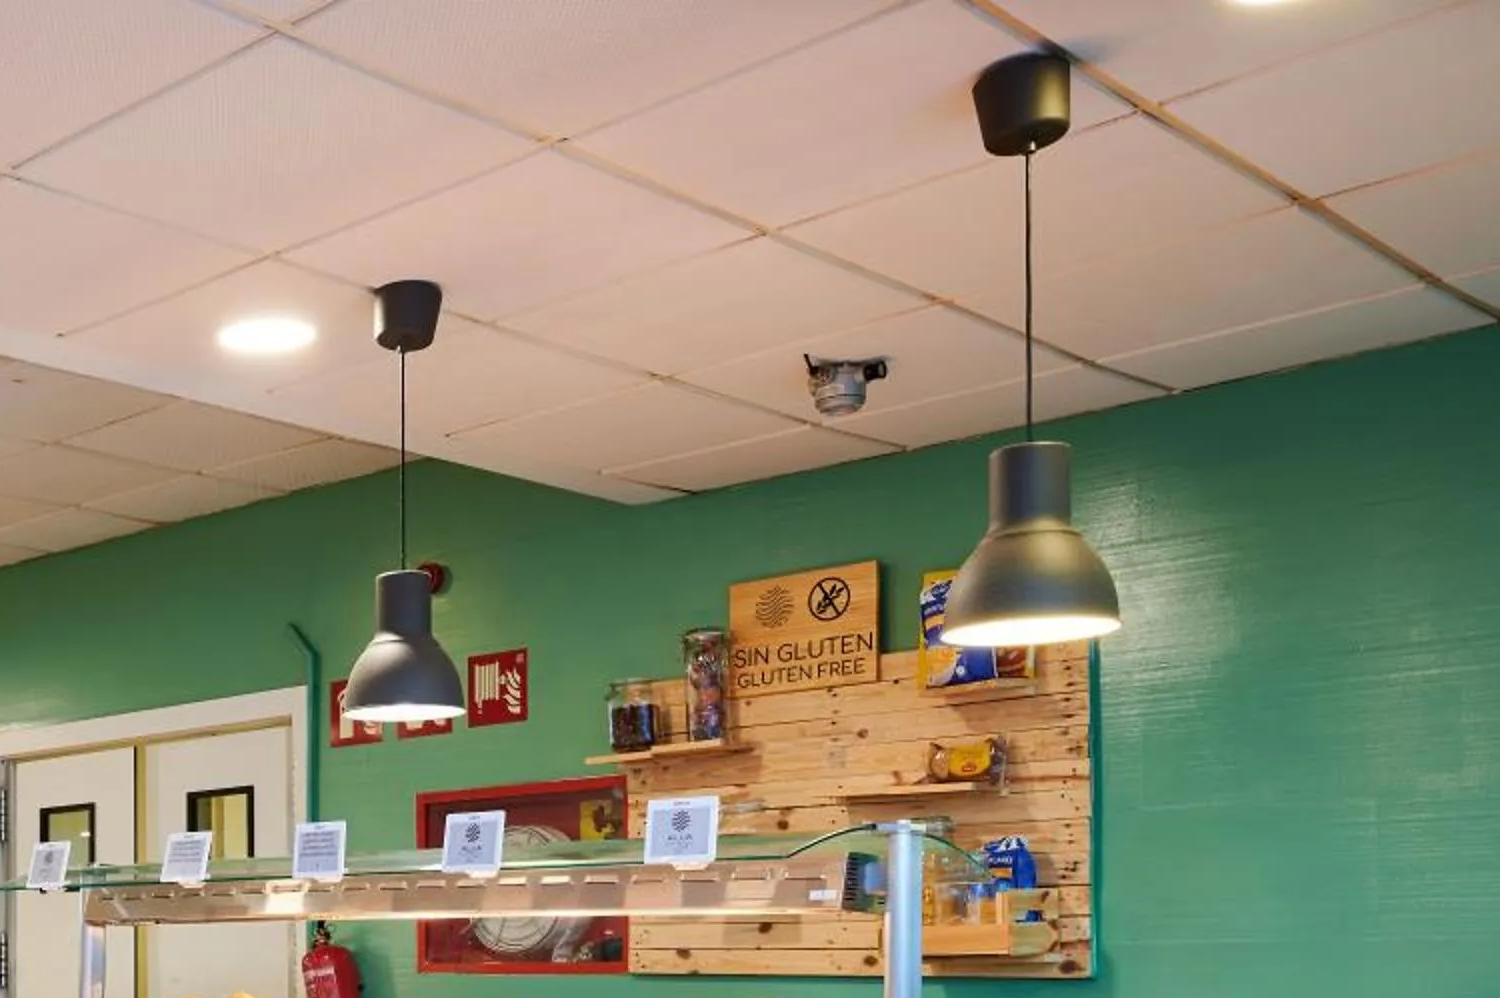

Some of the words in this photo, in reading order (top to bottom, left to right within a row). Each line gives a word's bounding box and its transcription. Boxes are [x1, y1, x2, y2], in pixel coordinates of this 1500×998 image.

[733, 646, 769, 669] SIN
[777, 631, 874, 663] GLUTEN
[737, 664, 813, 689] GLUTEN
[817, 657, 867, 679] FREE
